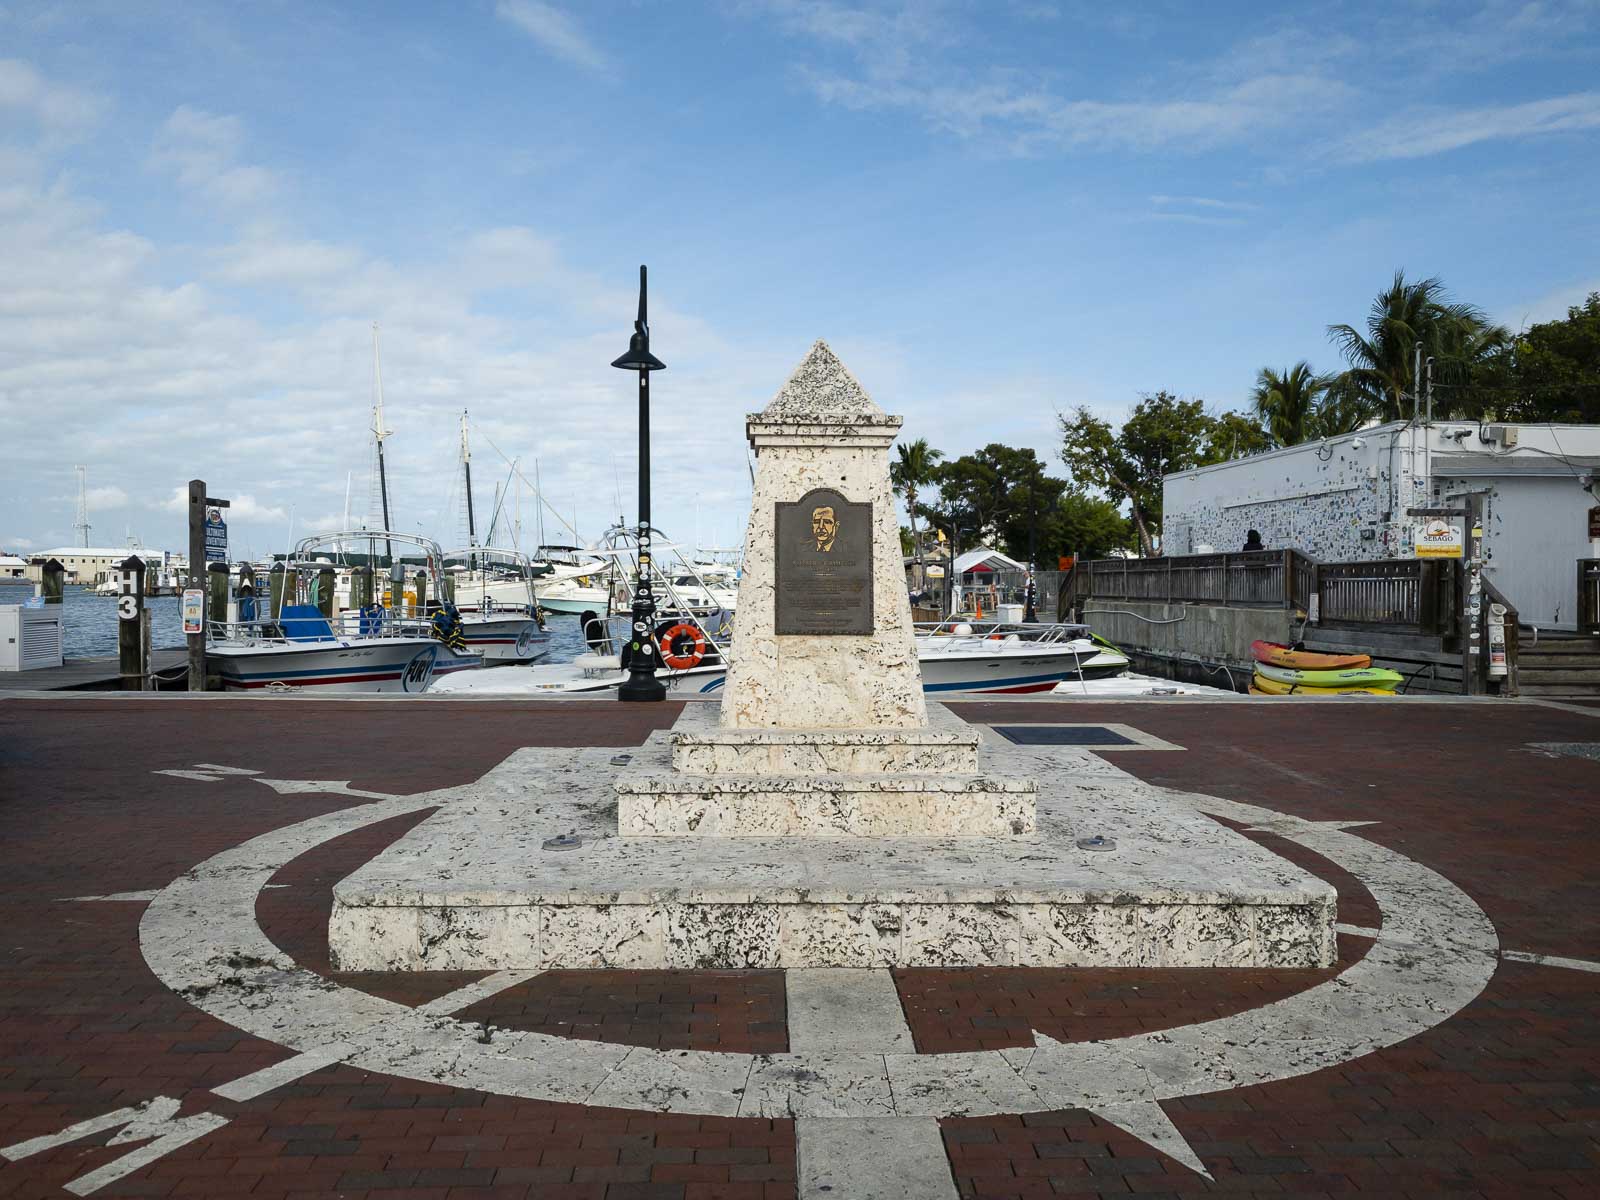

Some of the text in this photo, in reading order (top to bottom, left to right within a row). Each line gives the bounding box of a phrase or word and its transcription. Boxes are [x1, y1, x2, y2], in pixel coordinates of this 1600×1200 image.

[118, 571, 138, 594] H
[118, 596, 138, 620] 3
[407, 660, 433, 683] FURY
